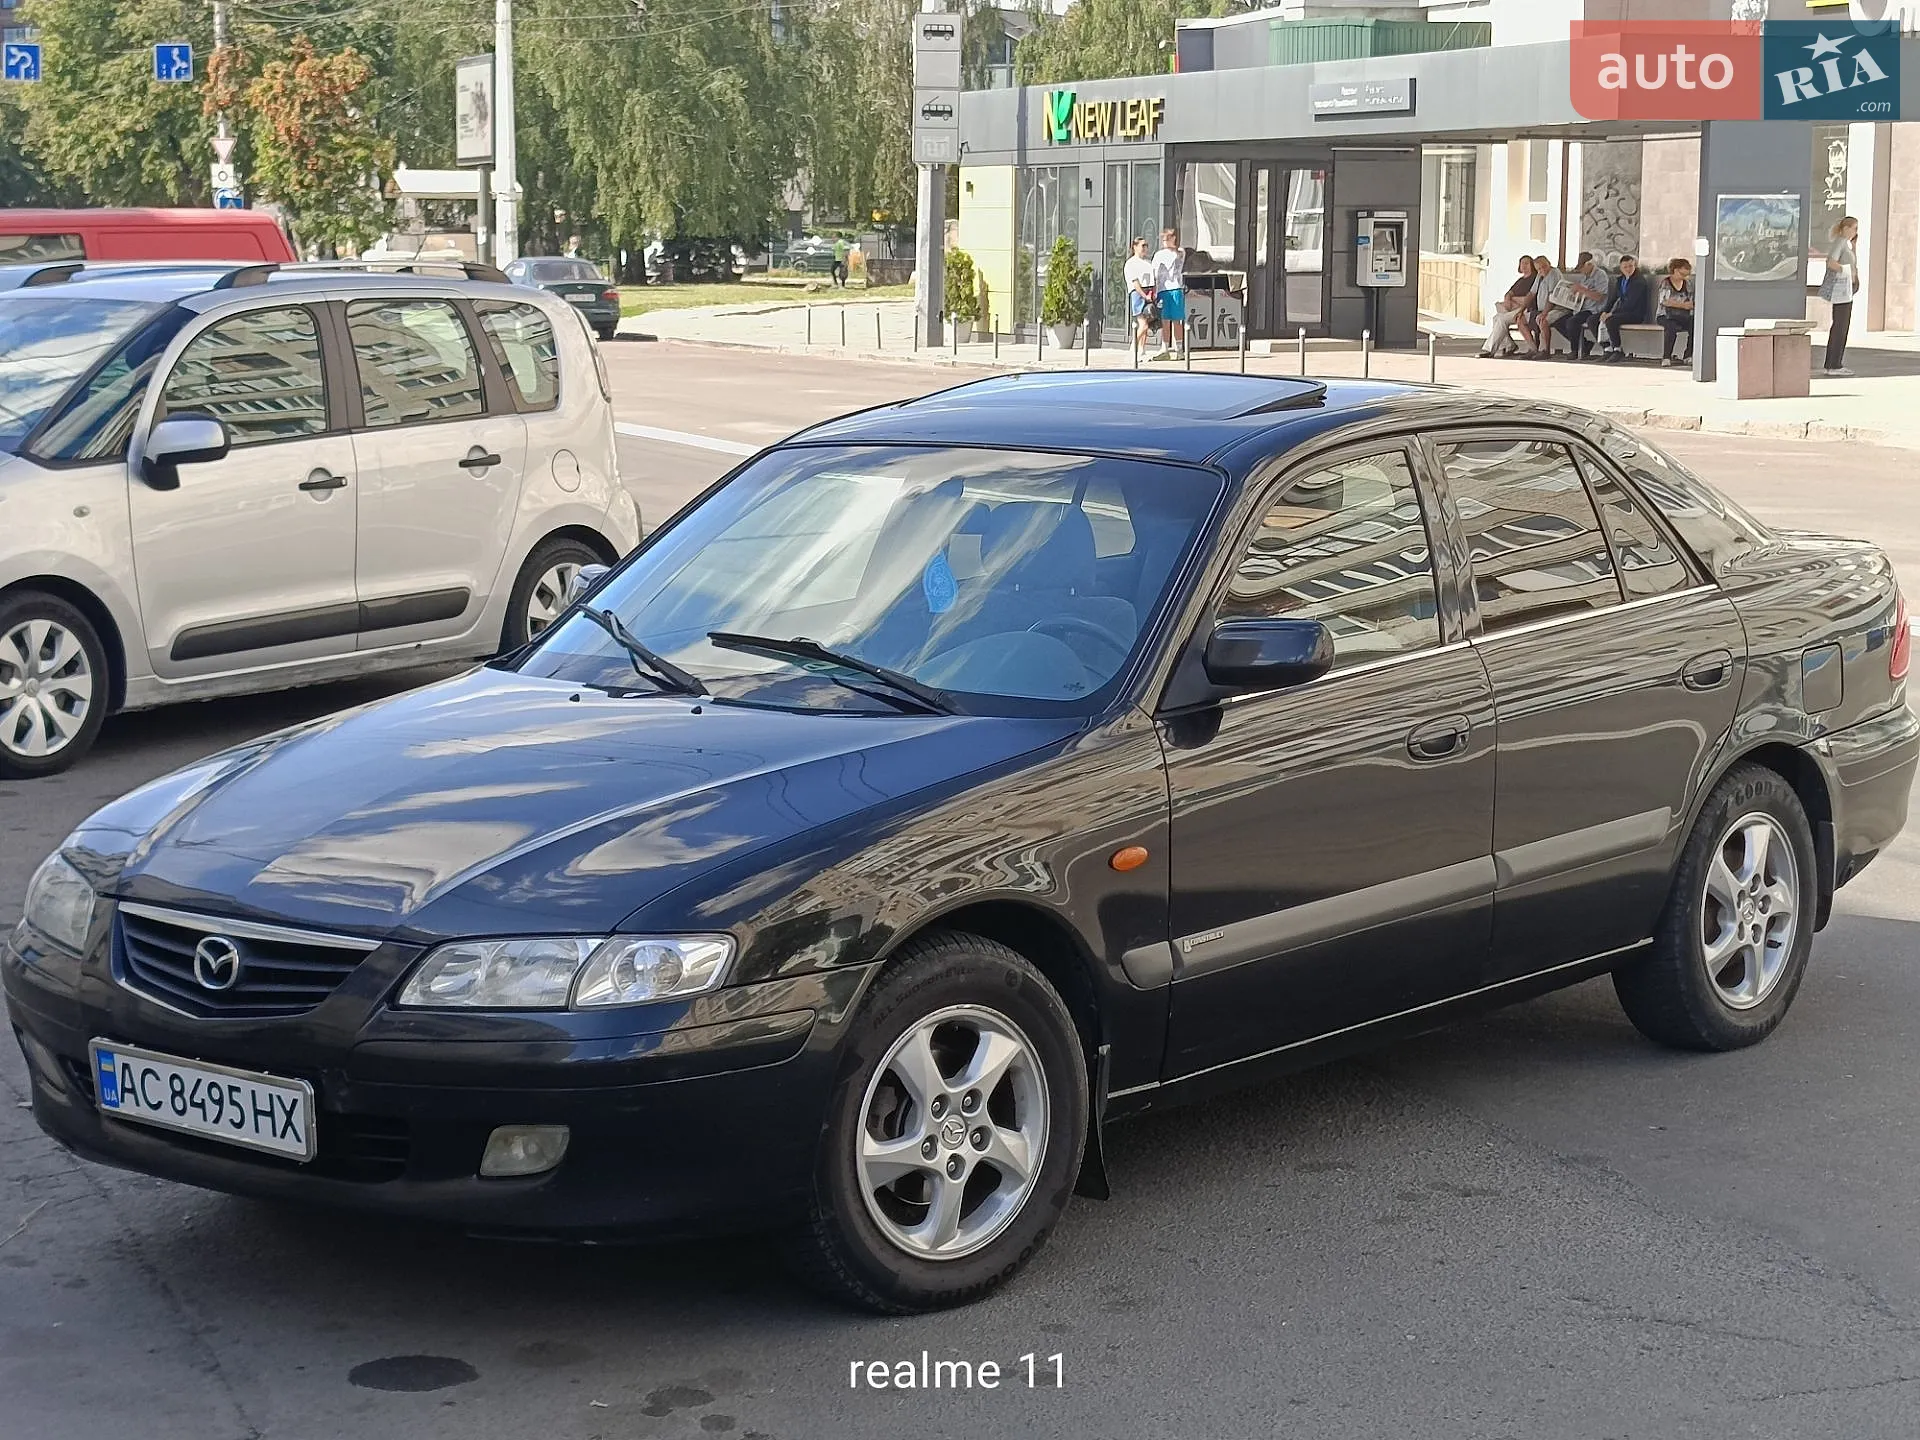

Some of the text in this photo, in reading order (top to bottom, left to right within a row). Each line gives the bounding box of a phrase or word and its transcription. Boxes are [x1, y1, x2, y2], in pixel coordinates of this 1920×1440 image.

[1072, 101, 1114, 139] NEW
[1117, 97, 1162, 137] LEAF
[104, 1087, 118, 1103] UA
[120, 1062, 303, 1143] AC 8495 HX
